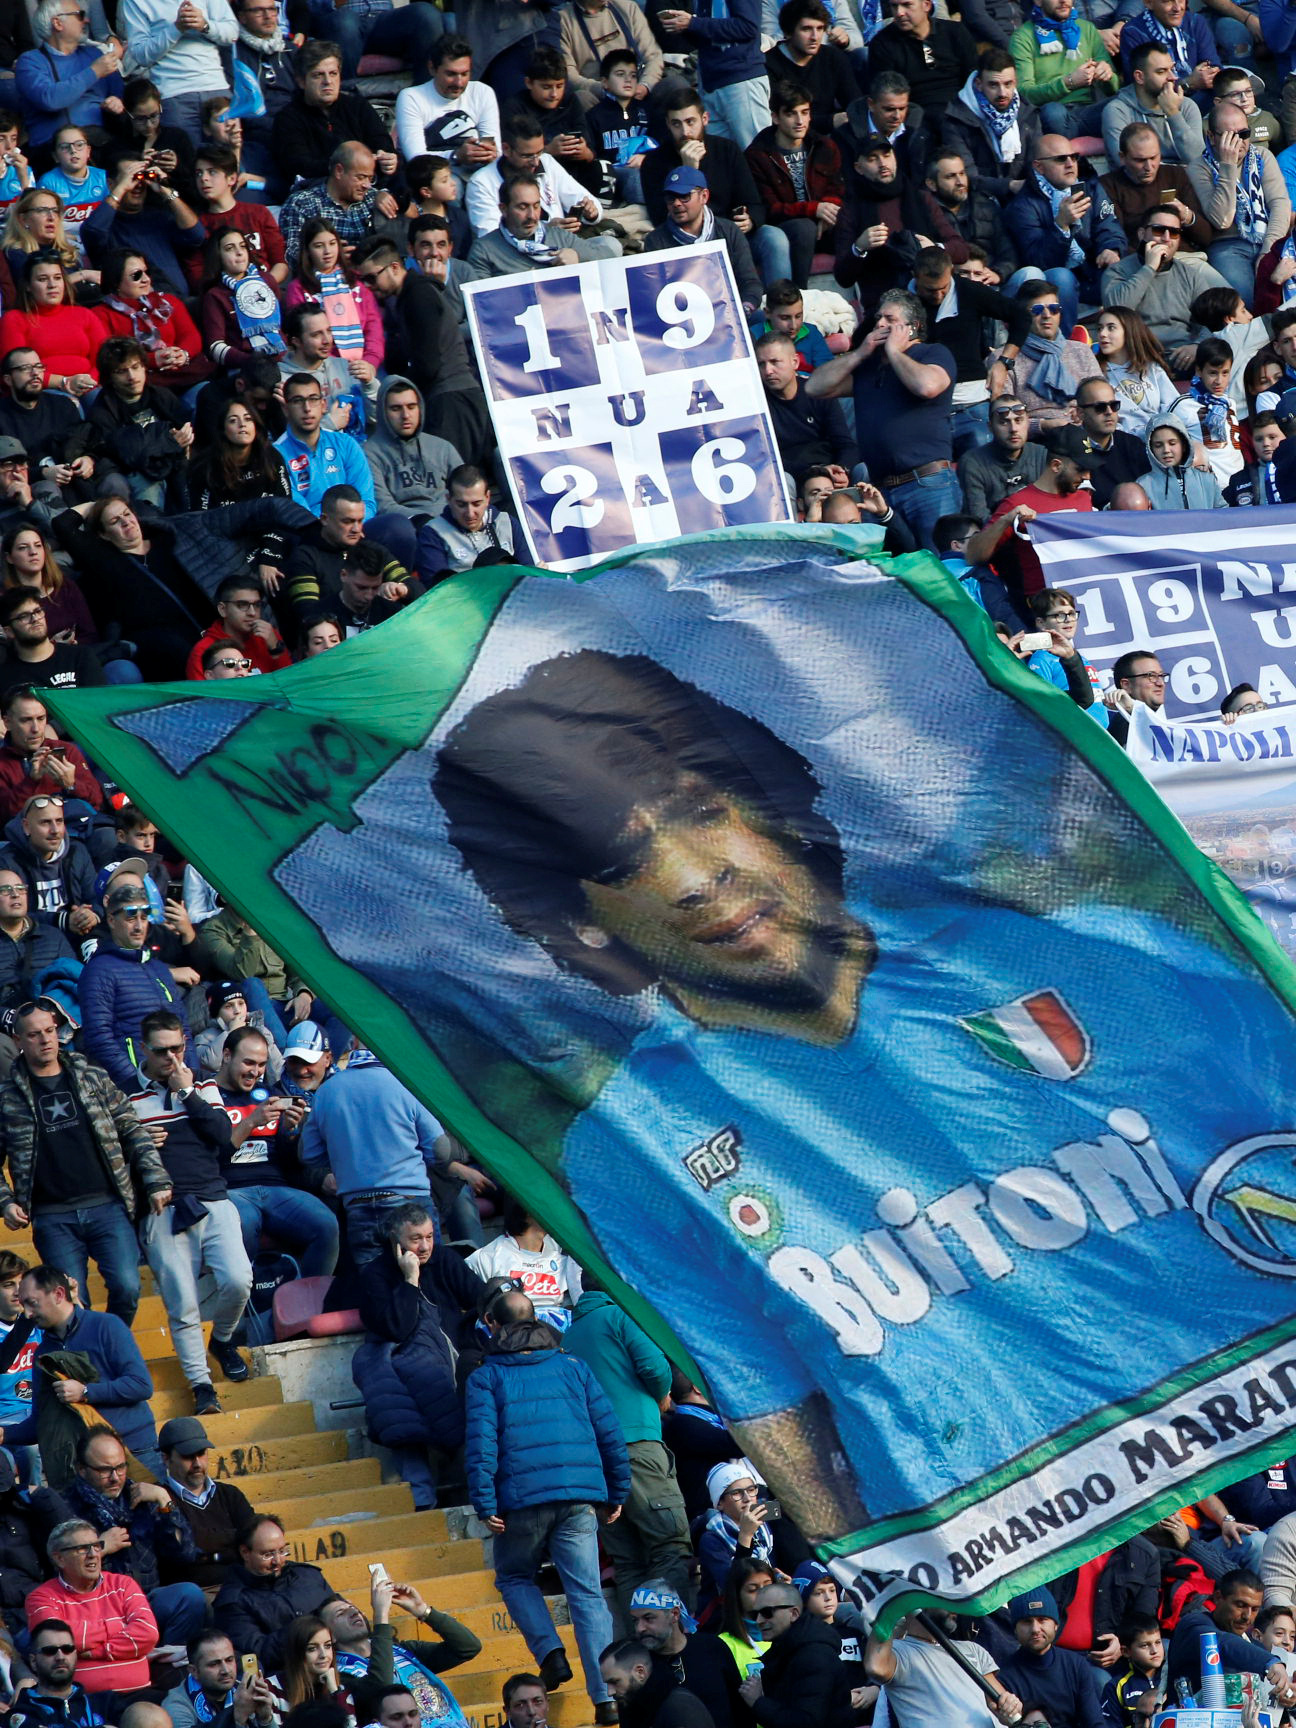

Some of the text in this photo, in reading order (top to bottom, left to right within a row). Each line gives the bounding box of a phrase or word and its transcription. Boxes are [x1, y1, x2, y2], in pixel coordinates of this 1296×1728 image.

[63, 204, 93, 222] Let
[514, 281, 715, 374] 1 N 9
[530, 379, 724, 442] N U A
[540, 437, 757, 535] 2 A 6
[1076, 578, 1195, 636] 1 9
[1170, 656, 1219, 704] 6
[1150, 724, 1293, 763] NAPOLI
[521, 1271, 559, 1296] Lete
